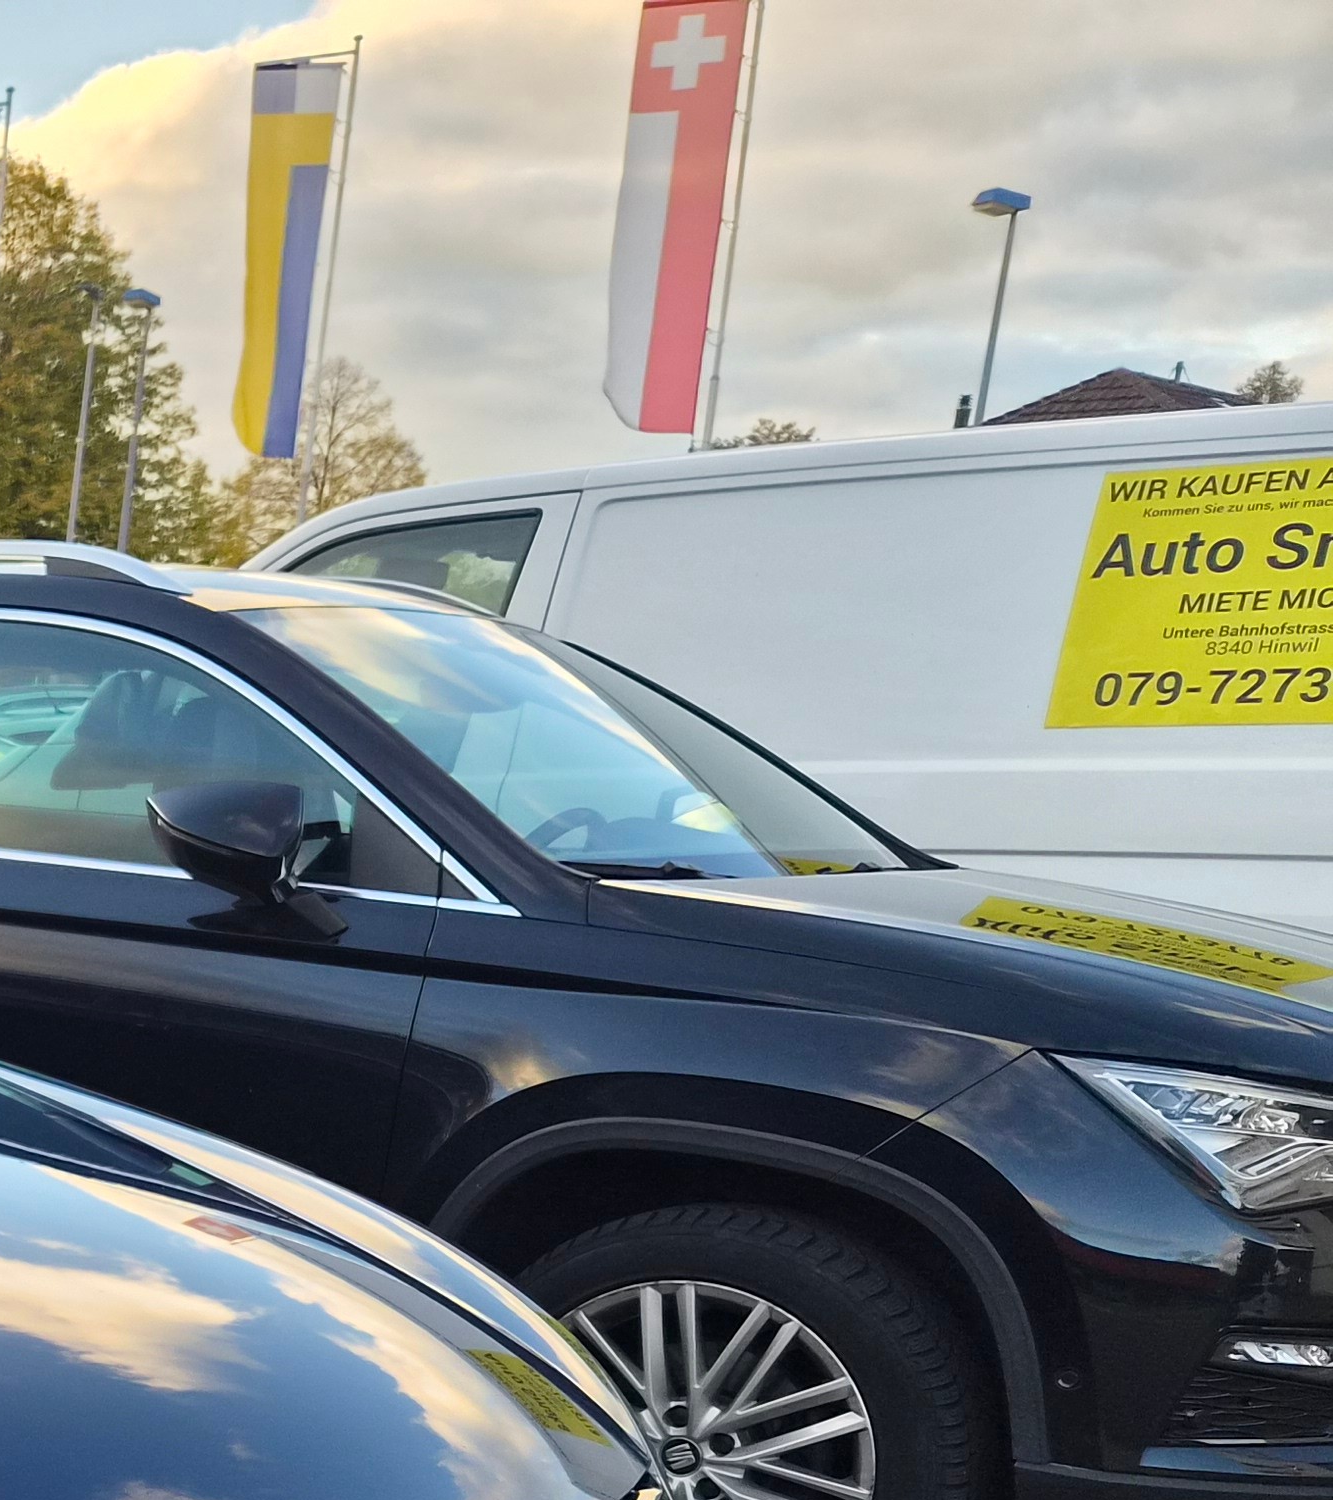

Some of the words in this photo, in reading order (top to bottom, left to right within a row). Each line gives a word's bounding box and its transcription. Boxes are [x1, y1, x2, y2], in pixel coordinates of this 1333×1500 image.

[1109, 478, 1168, 503] WIR
[1176, 468, 1311, 499] KAUFEN
[1142, 505, 1200, 519] Kommen
[1203, 503, 1224, 515] Sie
[1227, 503, 1244, 513] zu
[1247, 502, 1275, 512] uns,
[1279, 498, 1300, 510] wir
[1091, 531, 1245, 579] Auto
[1178, 589, 1272, 615] MIETE
[1162, 624, 1214, 640] Untere
[1204, 639, 1253, 656] 8340
[1257, 637, 1320, 655] Hinwil
[1094, 666, 1332, 707] 079-7273
